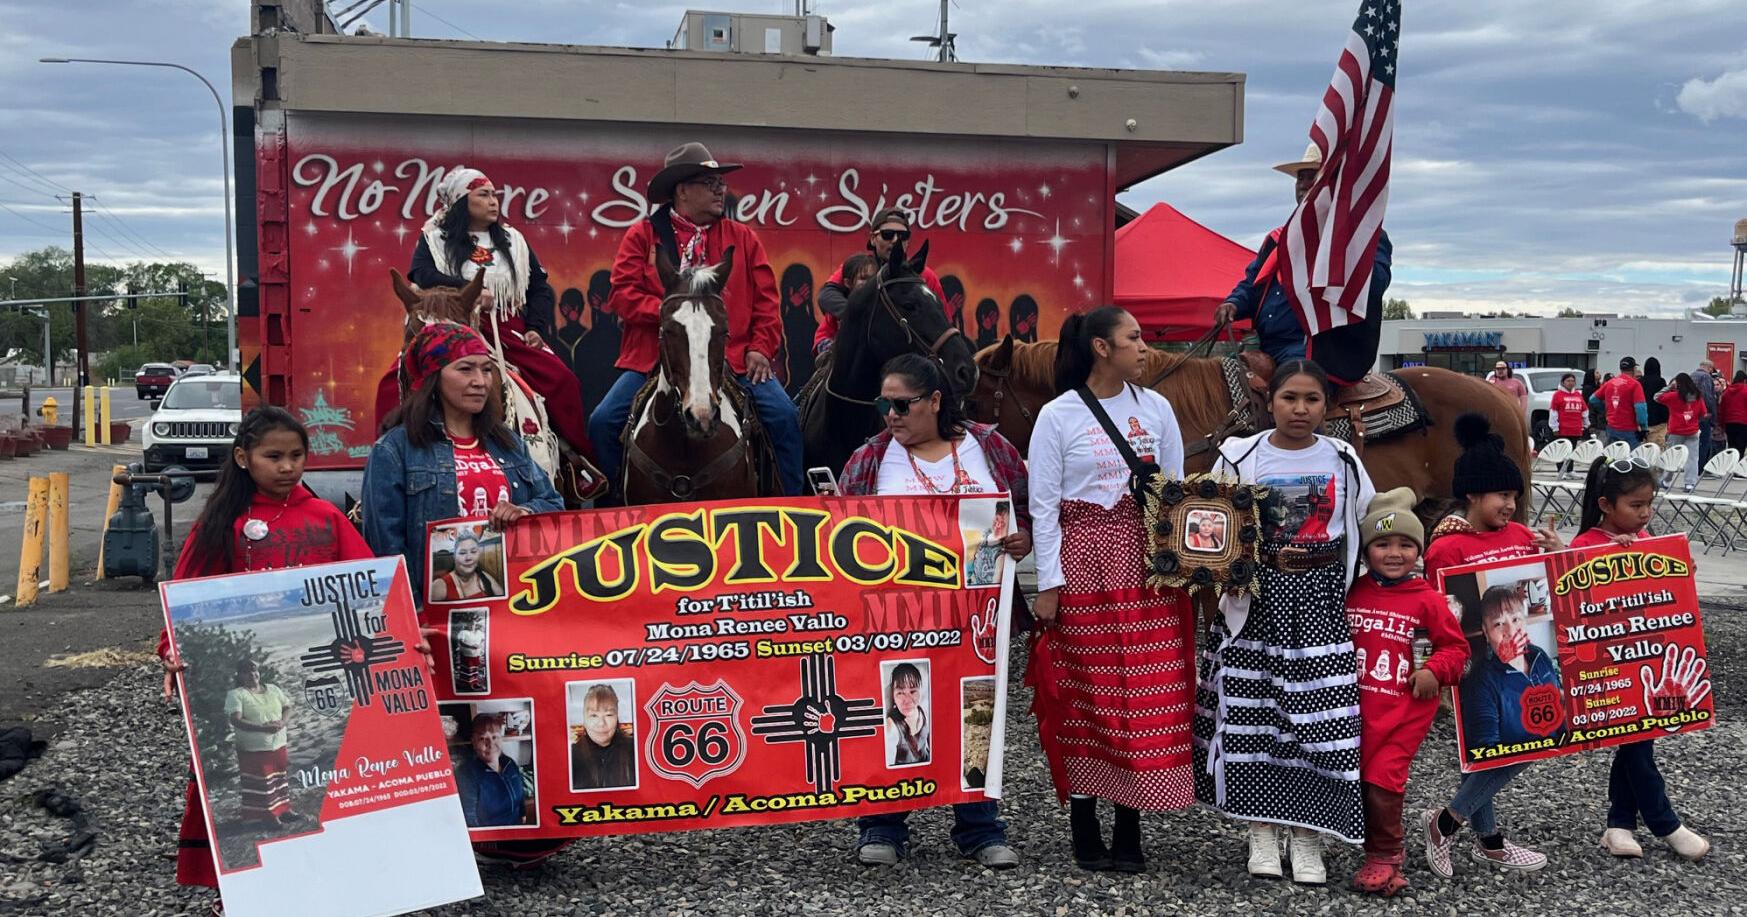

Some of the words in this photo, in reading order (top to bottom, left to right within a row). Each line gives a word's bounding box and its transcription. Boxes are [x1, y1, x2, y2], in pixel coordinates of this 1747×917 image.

[292, 153, 400, 221] No
[395, 158, 552, 221] Mre
[591, 165, 798, 228] Sen
[815, 168, 1046, 233] Sisters
[1423, 331, 1504, 350] YAKAMART
[509, 506, 962, 616] JUSTICE
[1555, 552, 1689, 596] JUSTICE
[301, 570, 381, 607] JUSTICE
[677, 597, 716, 615] for
[718, 590, 813, 611] T'itil'ish
[1579, 602, 1605, 615] for
[1606, 589, 1674, 610] T'itil'ish
[363, 612, 388, 634] for
[647, 620, 714, 642] Mona
[716, 618, 788, 637] Renee
[790, 611, 848, 632] Vallo
[1347, 613, 1415, 638] EDgalia
[1565, 618, 1627, 643] Mona
[1628, 610, 1695, 634] Renee
[508, 652, 603, 672] Sunrise
[605, 641, 750, 667] 07/24/1965
[757, 638, 834, 658] Sunset
[836, 629, 962, 652] 03/09/2022
[1607, 639, 1664, 662] Vallo
[375, 667, 424, 692] MONA
[1579, 665, 1620, 681] Sunrise
[315, 688, 337, 710] 66
[1570, 678, 1633, 697] 07/24/1965
[381, 690, 428, 714] VALLO
[662, 696, 728, 715] ROUTE
[1530, 704, 1555, 724] 66
[1585, 694, 1622, 709] Sunset
[1572, 706, 1638, 725] 03/09/2022
[662, 720, 730, 767] 66
[1469, 737, 1556, 761] Yakama
[1569, 720, 1640, 744] Acoma
[1640, 708, 1711, 730] Pueblo
[298, 766, 350, 788] Mona
[355, 756, 399, 778] Renee
[403, 745, 443, 767] Vallo
[328, 784, 370, 799] YAKAMA
[379, 775, 415, 790] ACOMA
[416, 768, 453, 781] PUEBLO
[555, 801, 699, 825] Yakama
[722, 790, 837, 814] Acoma
[842, 779, 938, 804] Pueblo
